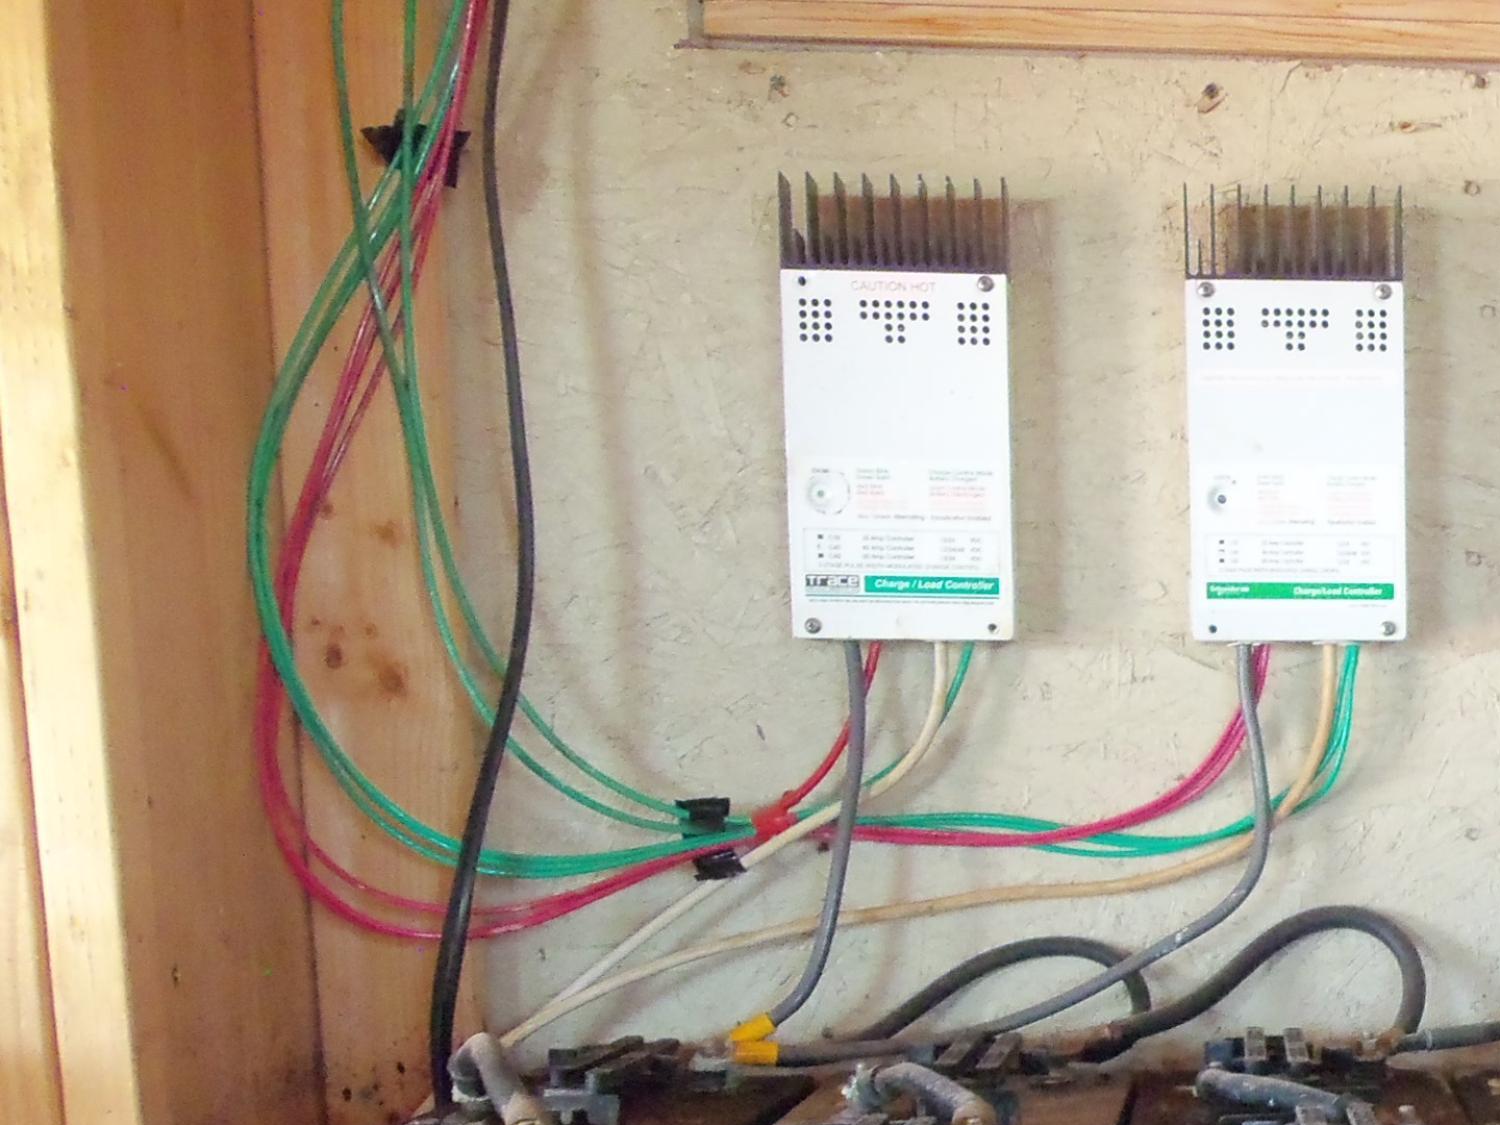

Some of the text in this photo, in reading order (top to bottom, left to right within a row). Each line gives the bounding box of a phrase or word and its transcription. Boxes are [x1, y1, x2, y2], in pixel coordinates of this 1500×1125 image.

[850, 280, 936, 292] CAUTION HOT
[874, 578, 910, 590] Charge
[918, 579, 942, 590] Load
[945, 580, 995, 591] Controller
[1343, 586, 1383, 596] Controller
